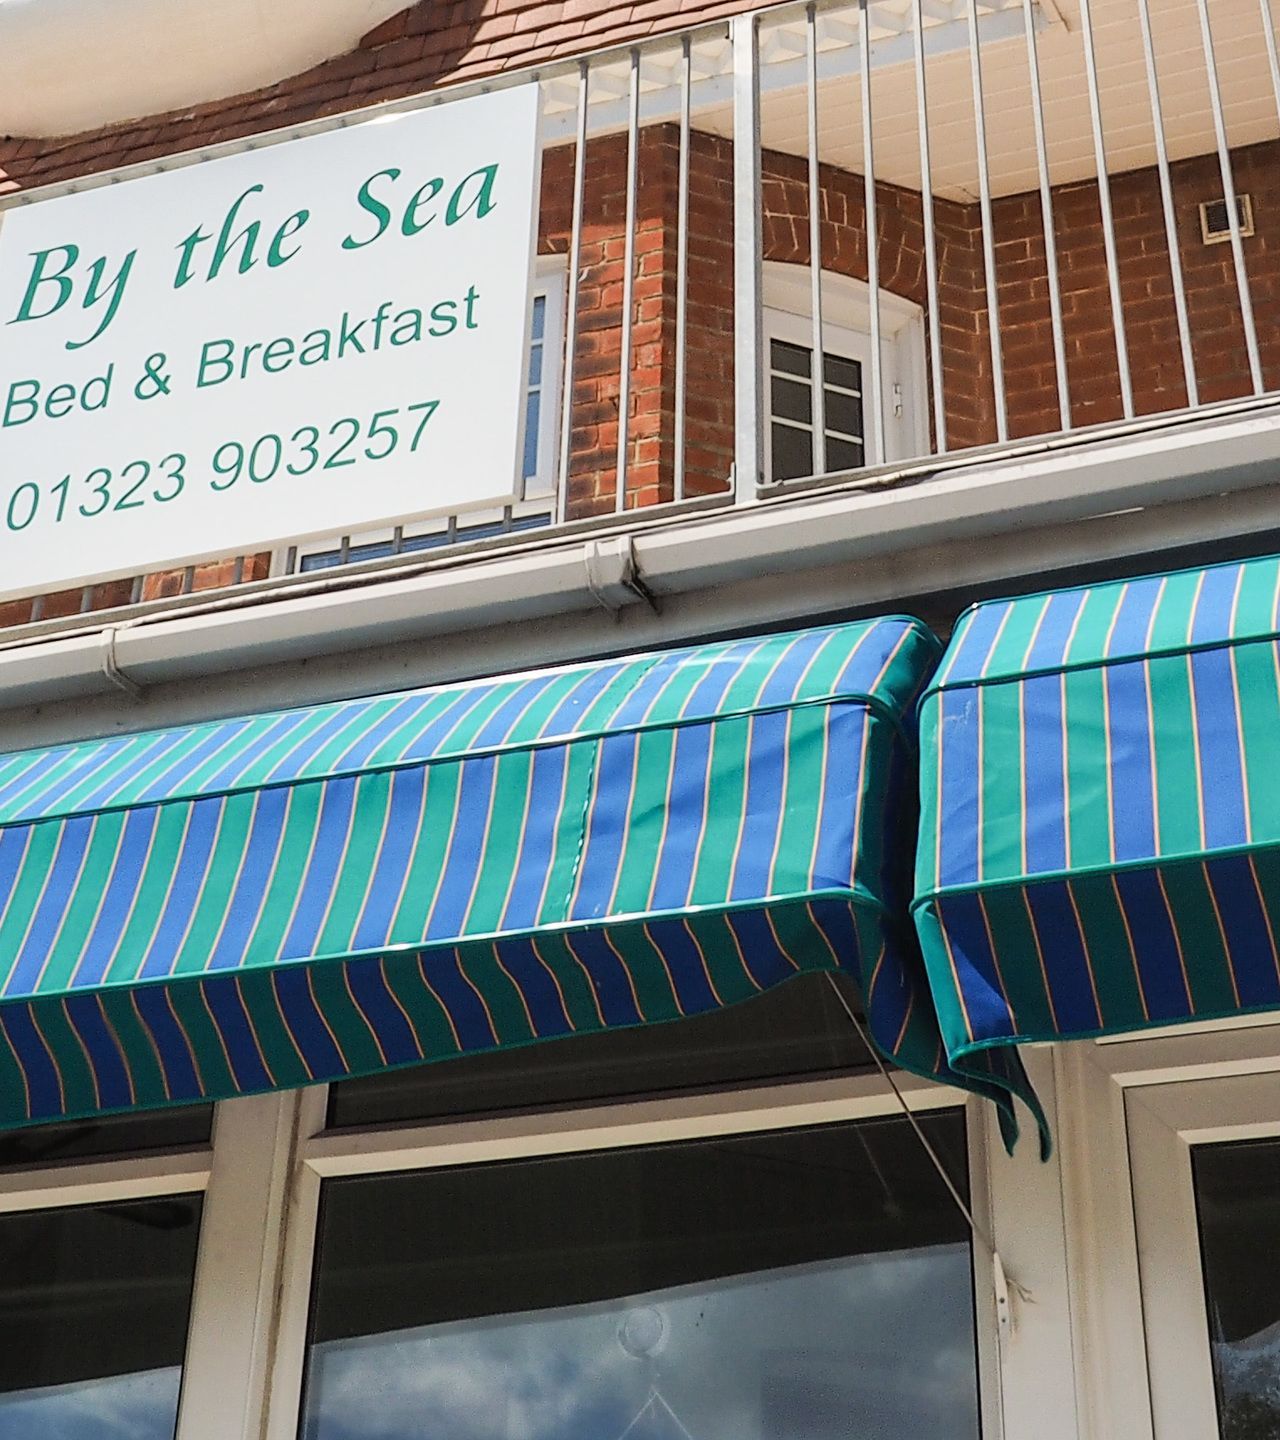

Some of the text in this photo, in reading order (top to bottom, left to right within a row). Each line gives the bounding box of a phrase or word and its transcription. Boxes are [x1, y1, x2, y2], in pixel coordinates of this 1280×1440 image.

[5, 162, 500, 351] By the Sea
[1, 285, 480, 429] Bed & Breakfast
[5, 399, 441, 533] 01323 903257
